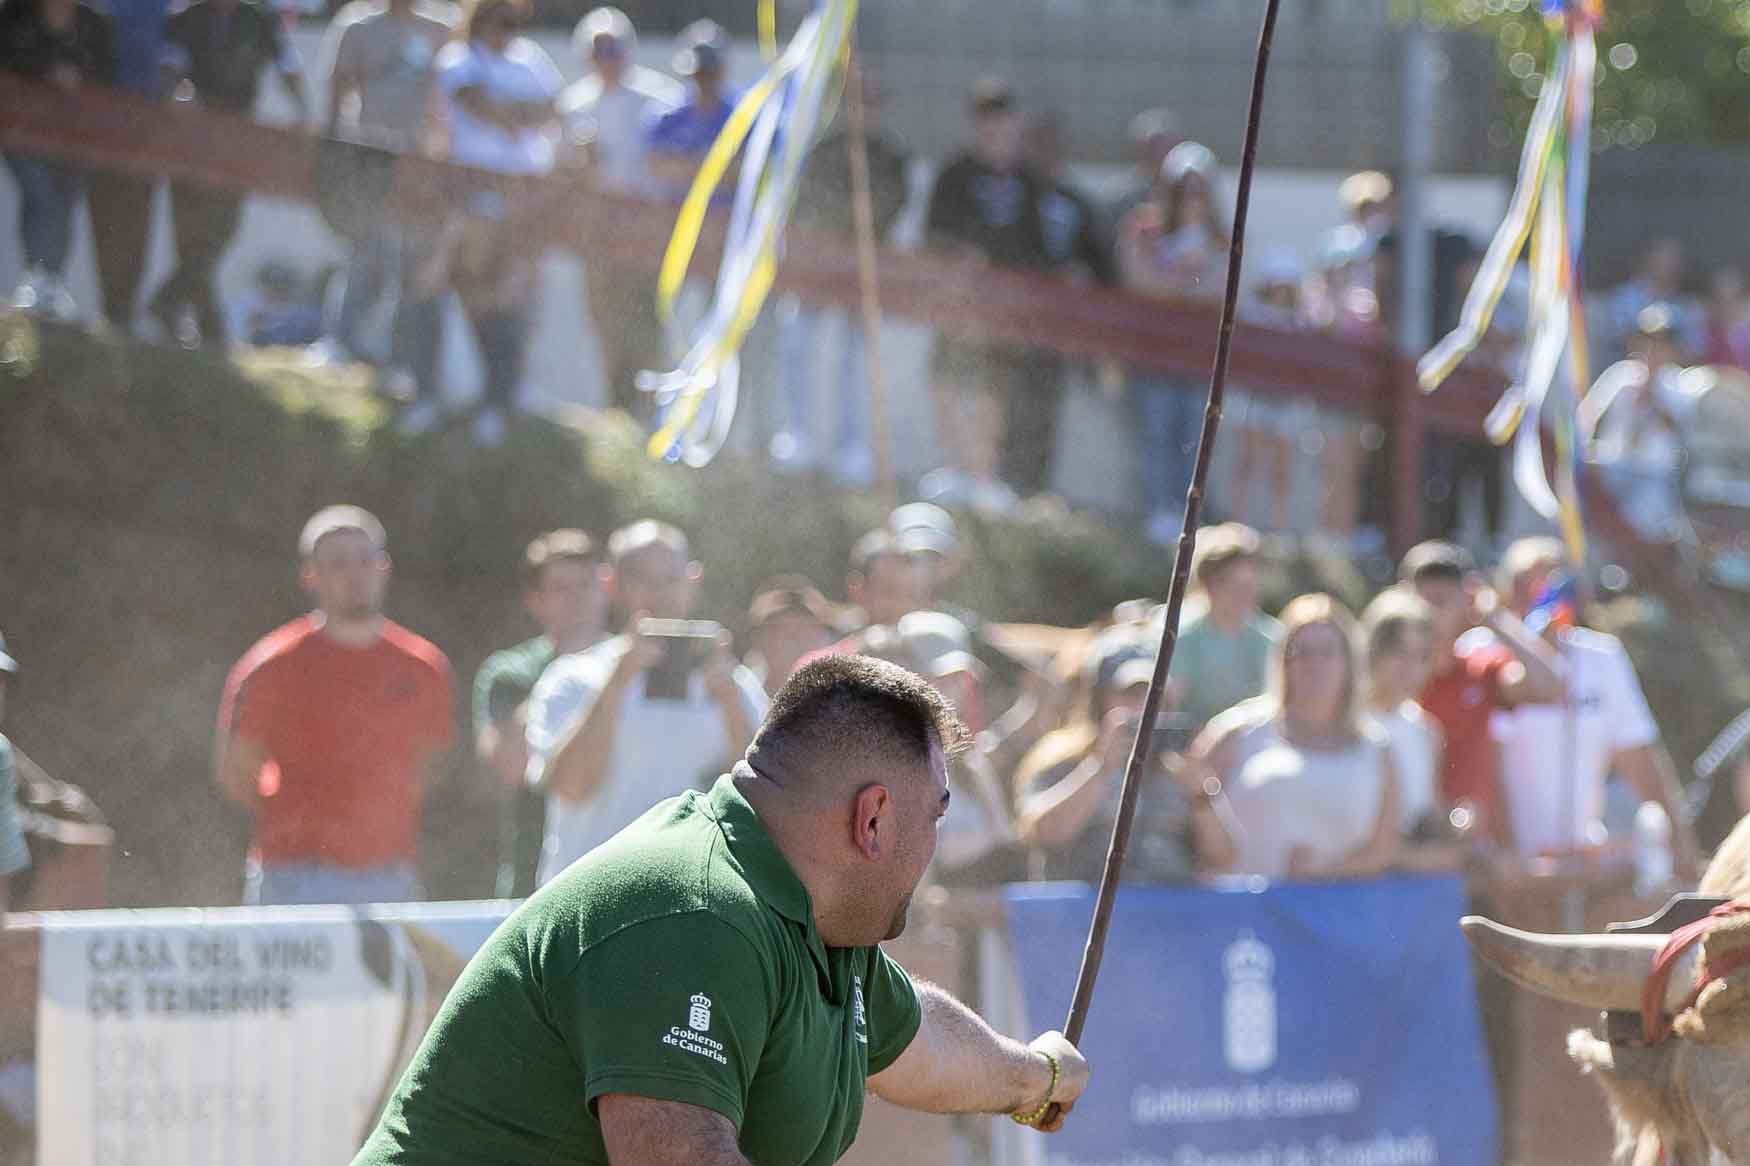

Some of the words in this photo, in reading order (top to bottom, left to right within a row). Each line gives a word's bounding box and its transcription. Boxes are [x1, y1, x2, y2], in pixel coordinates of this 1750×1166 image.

[87, 937, 178, 971] CASA
[187, 937, 243, 970] DEL
[258, 935, 335, 970] VINO
[88, 980, 131, 1017] DE
[663, 1034, 678, 1046] de
[680, 1039, 727, 1064] Canarias
[671, 1026, 723, 1050] Gobierno
